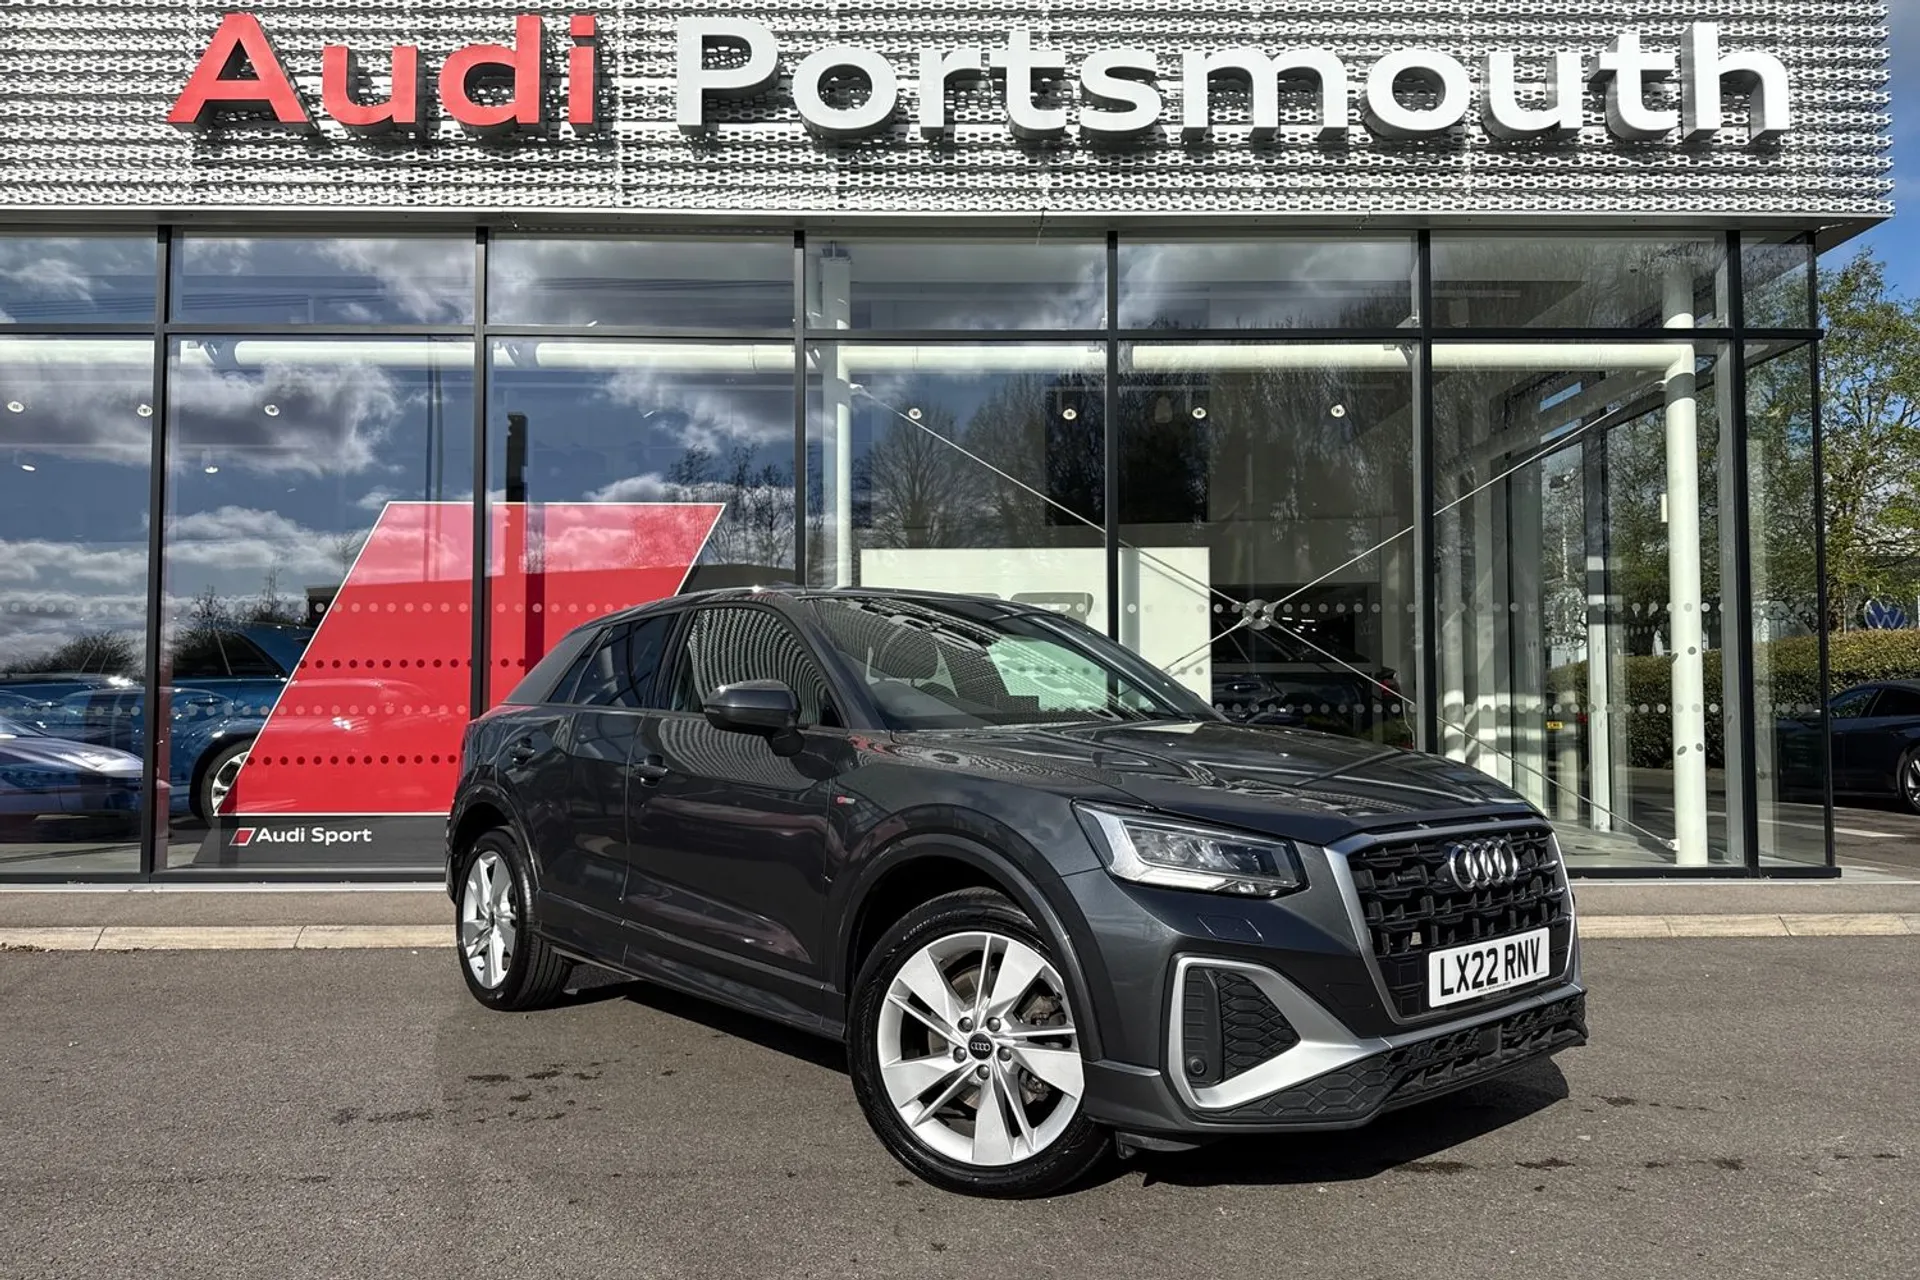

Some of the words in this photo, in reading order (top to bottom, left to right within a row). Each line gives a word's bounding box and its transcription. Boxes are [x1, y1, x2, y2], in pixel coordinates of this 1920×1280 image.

[166, 13, 598, 126] Audi
[676, 16, 1790, 136] Portsmouth
[256, 828, 305, 842] Audi
[311, 827, 372, 846] Sport
[1440, 947, 1499, 997] LX22
[1504, 937, 1540, 982] RNV
